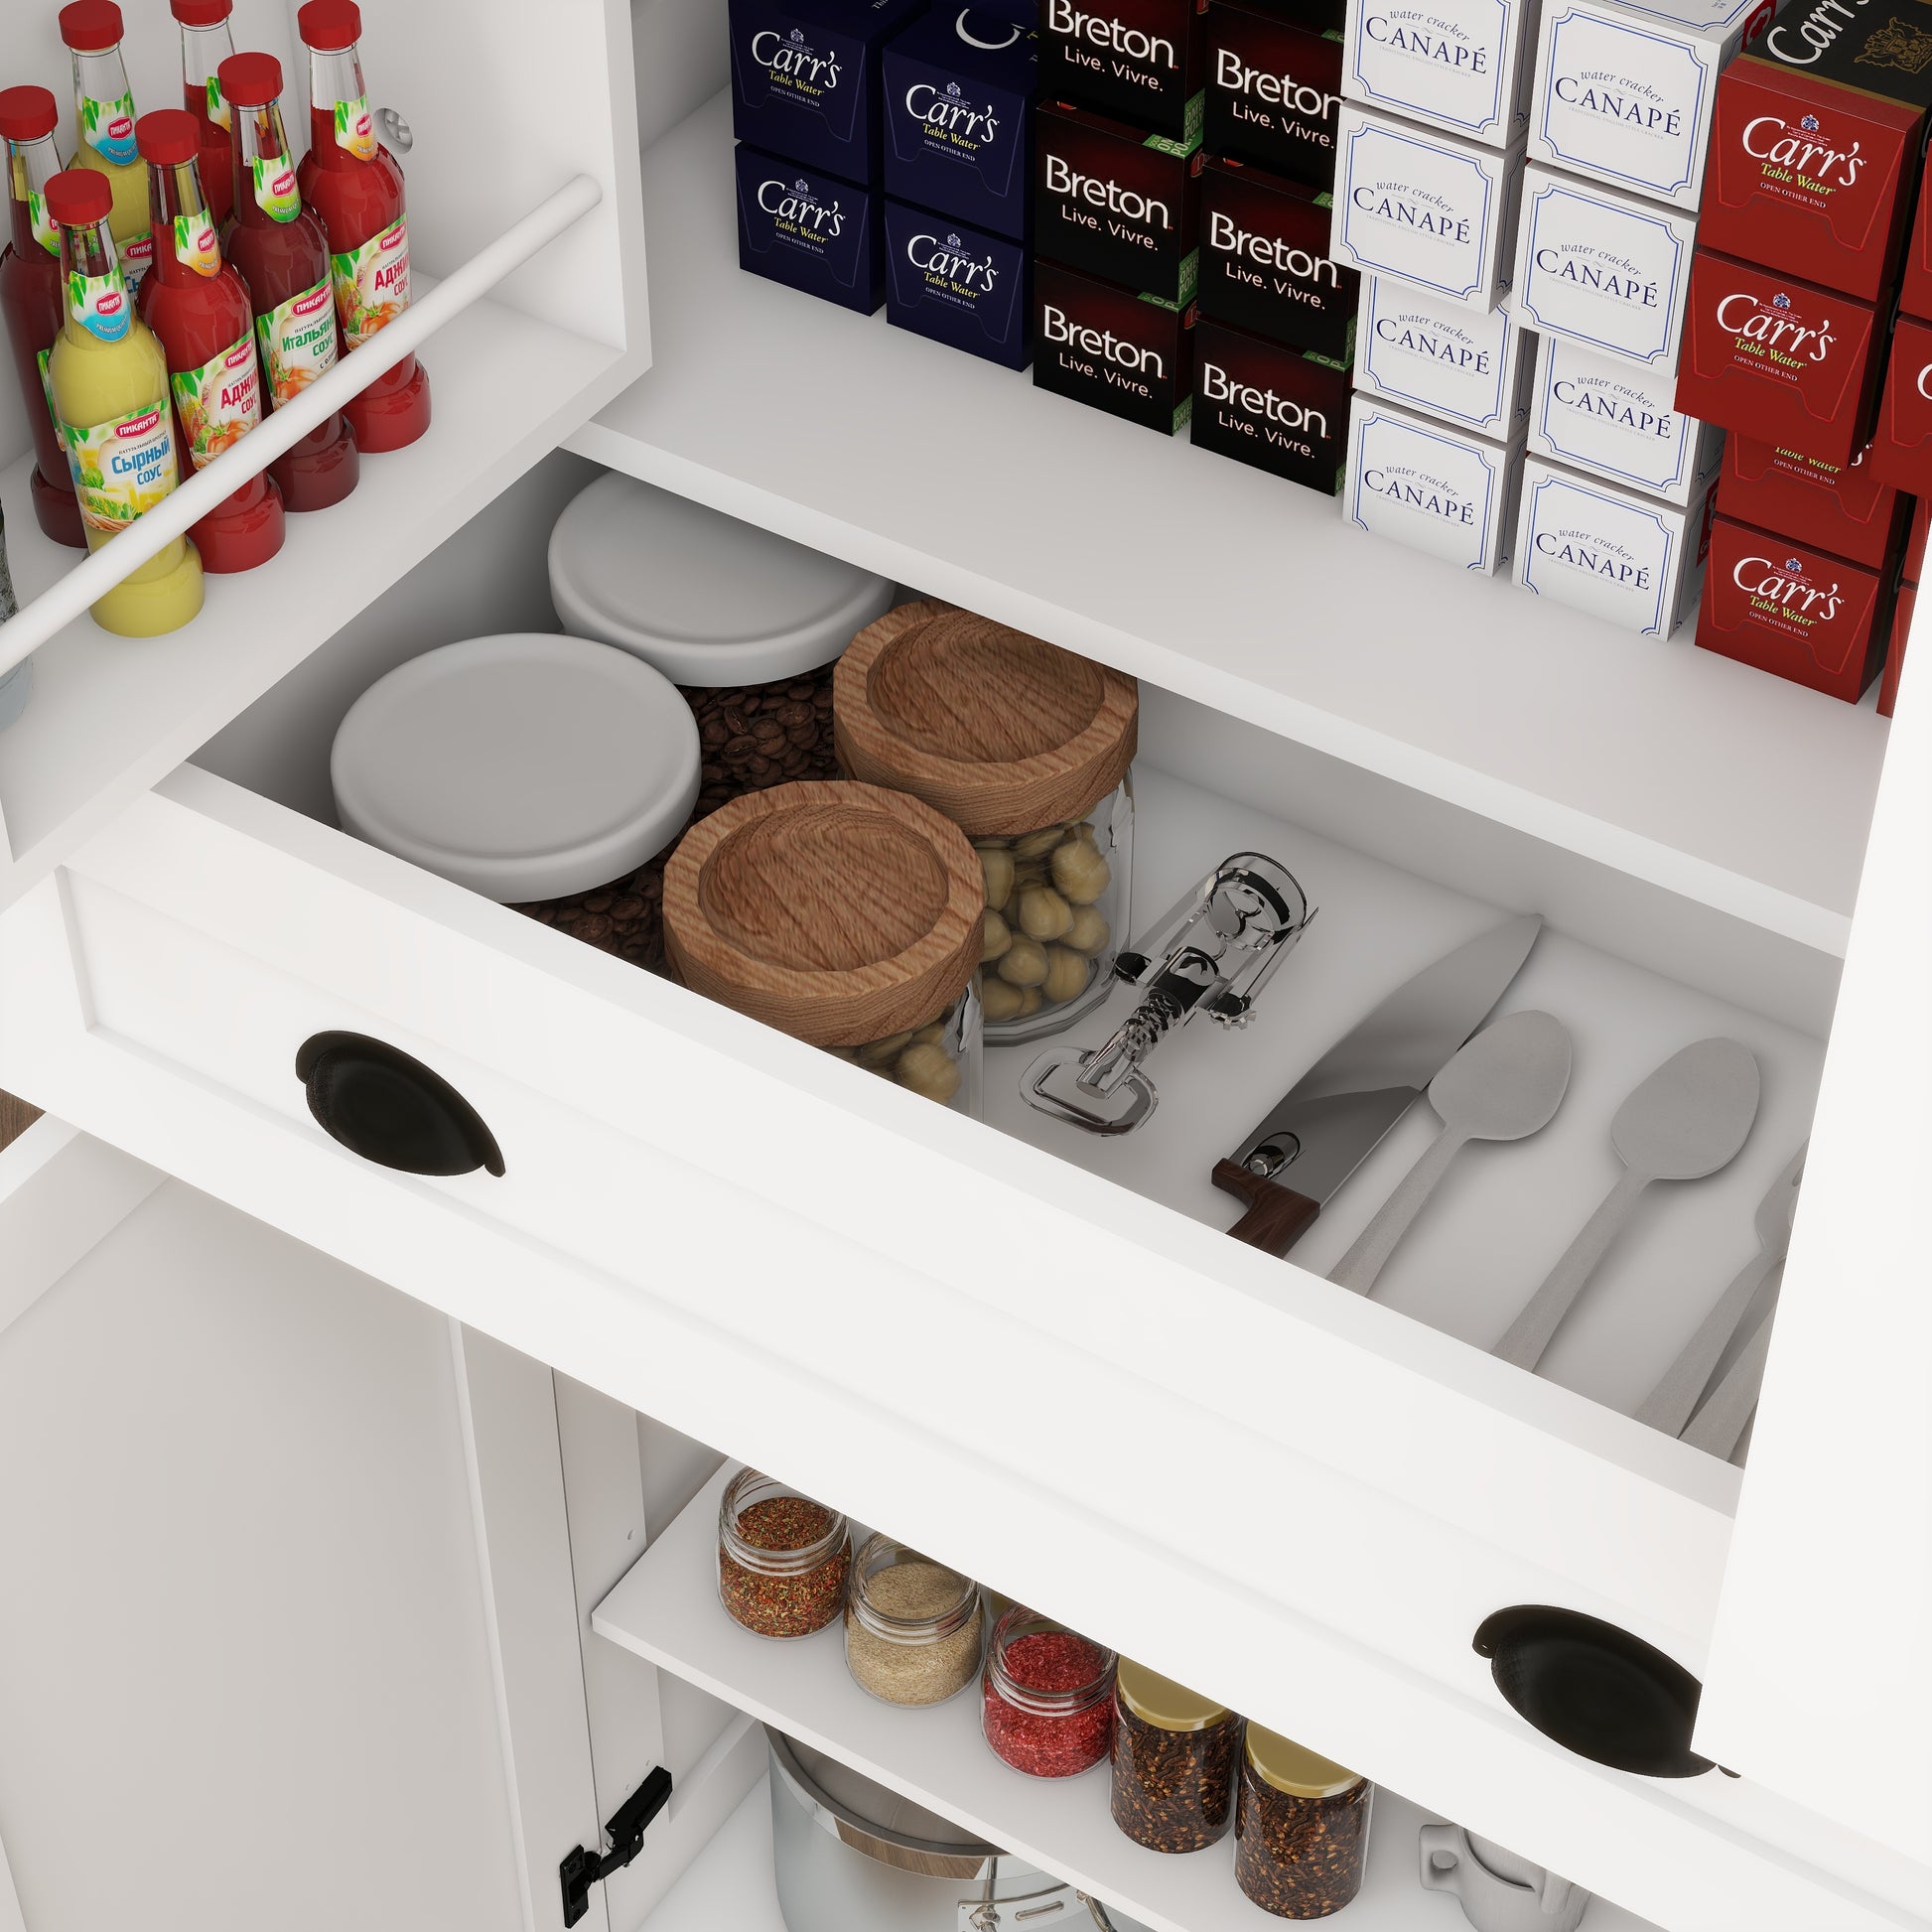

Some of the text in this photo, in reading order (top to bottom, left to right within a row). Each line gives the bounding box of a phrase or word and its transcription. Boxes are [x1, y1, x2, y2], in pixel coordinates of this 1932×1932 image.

[1048, 0, 1174, 69] Breton
[1366, 16, 1487, 74] CANAPÉ
[1390, 10, 1470, 41] water cracker
[752, 31, 841, 88] Carr's
[1064, 45, 1164, 92] Live. Vivre.
[769, 69, 823, 96] Table Water
[770, 85, 820, 107] OPEN OTHER END
[1581, 70, 1664, 103] water cracker
[905, 84, 998, 143] Carr's
[1232, 101, 1334, 149] Live. Vivre.
[1555, 76, 1681, 137] CANAPÉ
[922, 123, 979, 151] Table Water
[924, 139, 976, 162] OPEN OTHER END
[1742, 116, 1863, 187] Carr's
[1046, 154, 1170, 230] Breton
[1376, 182, 1454, 213] water cracker
[1760, 182, 1827, 208] OPEN OTHER END
[1761, 163, 1834, 196] Table Water
[758, 180, 844, 236] Carr's
[1062, 205, 1159, 251] Live. Vivre.
[1353, 187, 1470, 244] CANAPÉ
[129, 242, 152, 256] ПИКА
[774, 217, 827, 244] Table Water
[775, 232, 824, 254] OPEN OTHER END
[1210, 211, 1338, 288] Breton
[907, 234, 997, 292] Carr's
[1536, 248, 1658, 308] CANAPÉ
[1561, 243, 1642, 276] water cracker
[924, 271, 979, 299] Table Water
[925, 286, 975, 310] OPEN OTHER END
[1226, 262, 1325, 311] Live. Vivre.
[1043, 305, 1163, 379] Breton
[1376, 318, 1490, 375] CANAPÉ
[1399, 314, 1474, 345] water cracker
[1717, 294, 1834, 361] Carr's
[1059, 352, 1153, 398] Live. Vivre.
[1733, 354, 1798, 381] OPEN OTHER END
[1734, 338, 1805, 369] Table Water
[1203, 362, 1327, 439] Breton
[1553, 380, 1671, 439] CANAPÉ
[1578, 376, 1655, 408] water cracker
[119, 413, 158, 436] ПИКАНТА
[1218, 411, 1315, 459] Live. Vivre.
[111, 435, 171, 475] Сырный
[1774, 459, 1836, 485] OPEN OTHER END
[1364, 470, 1474, 526] CANAPÉ
[1386, 466, 1459, 497] water cracker
[1536, 532, 1650, 591] CANAPÉ
[1559, 529, 1635, 562] water cracker
[1733, 557, 1842, 621] Carr's
[1749, 596, 1816, 627] Table Water
[1749, 611, 1809, 637] OPEN OTHER END
